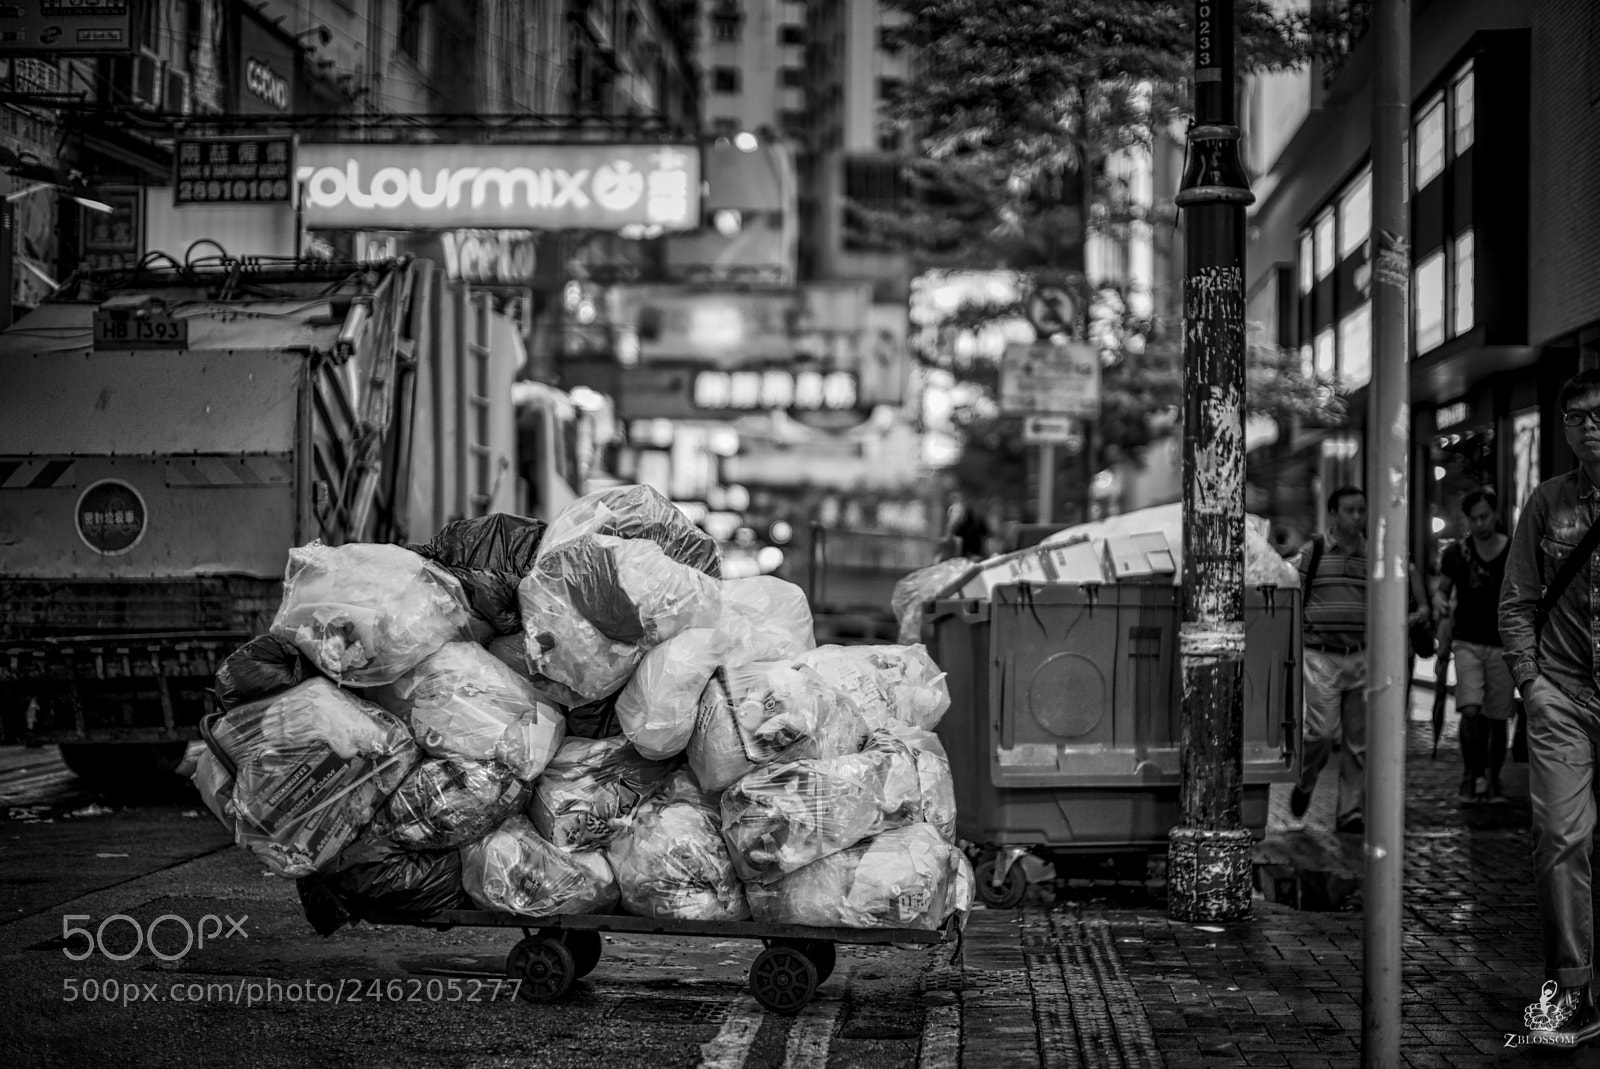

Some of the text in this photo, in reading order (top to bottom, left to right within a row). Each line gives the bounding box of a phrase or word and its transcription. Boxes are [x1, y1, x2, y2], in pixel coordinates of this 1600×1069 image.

[1199, 0, 1211, 66] 0233
[103, 322, 179, 338] HB 1393
[310, 767, 336, 793] FOAM
